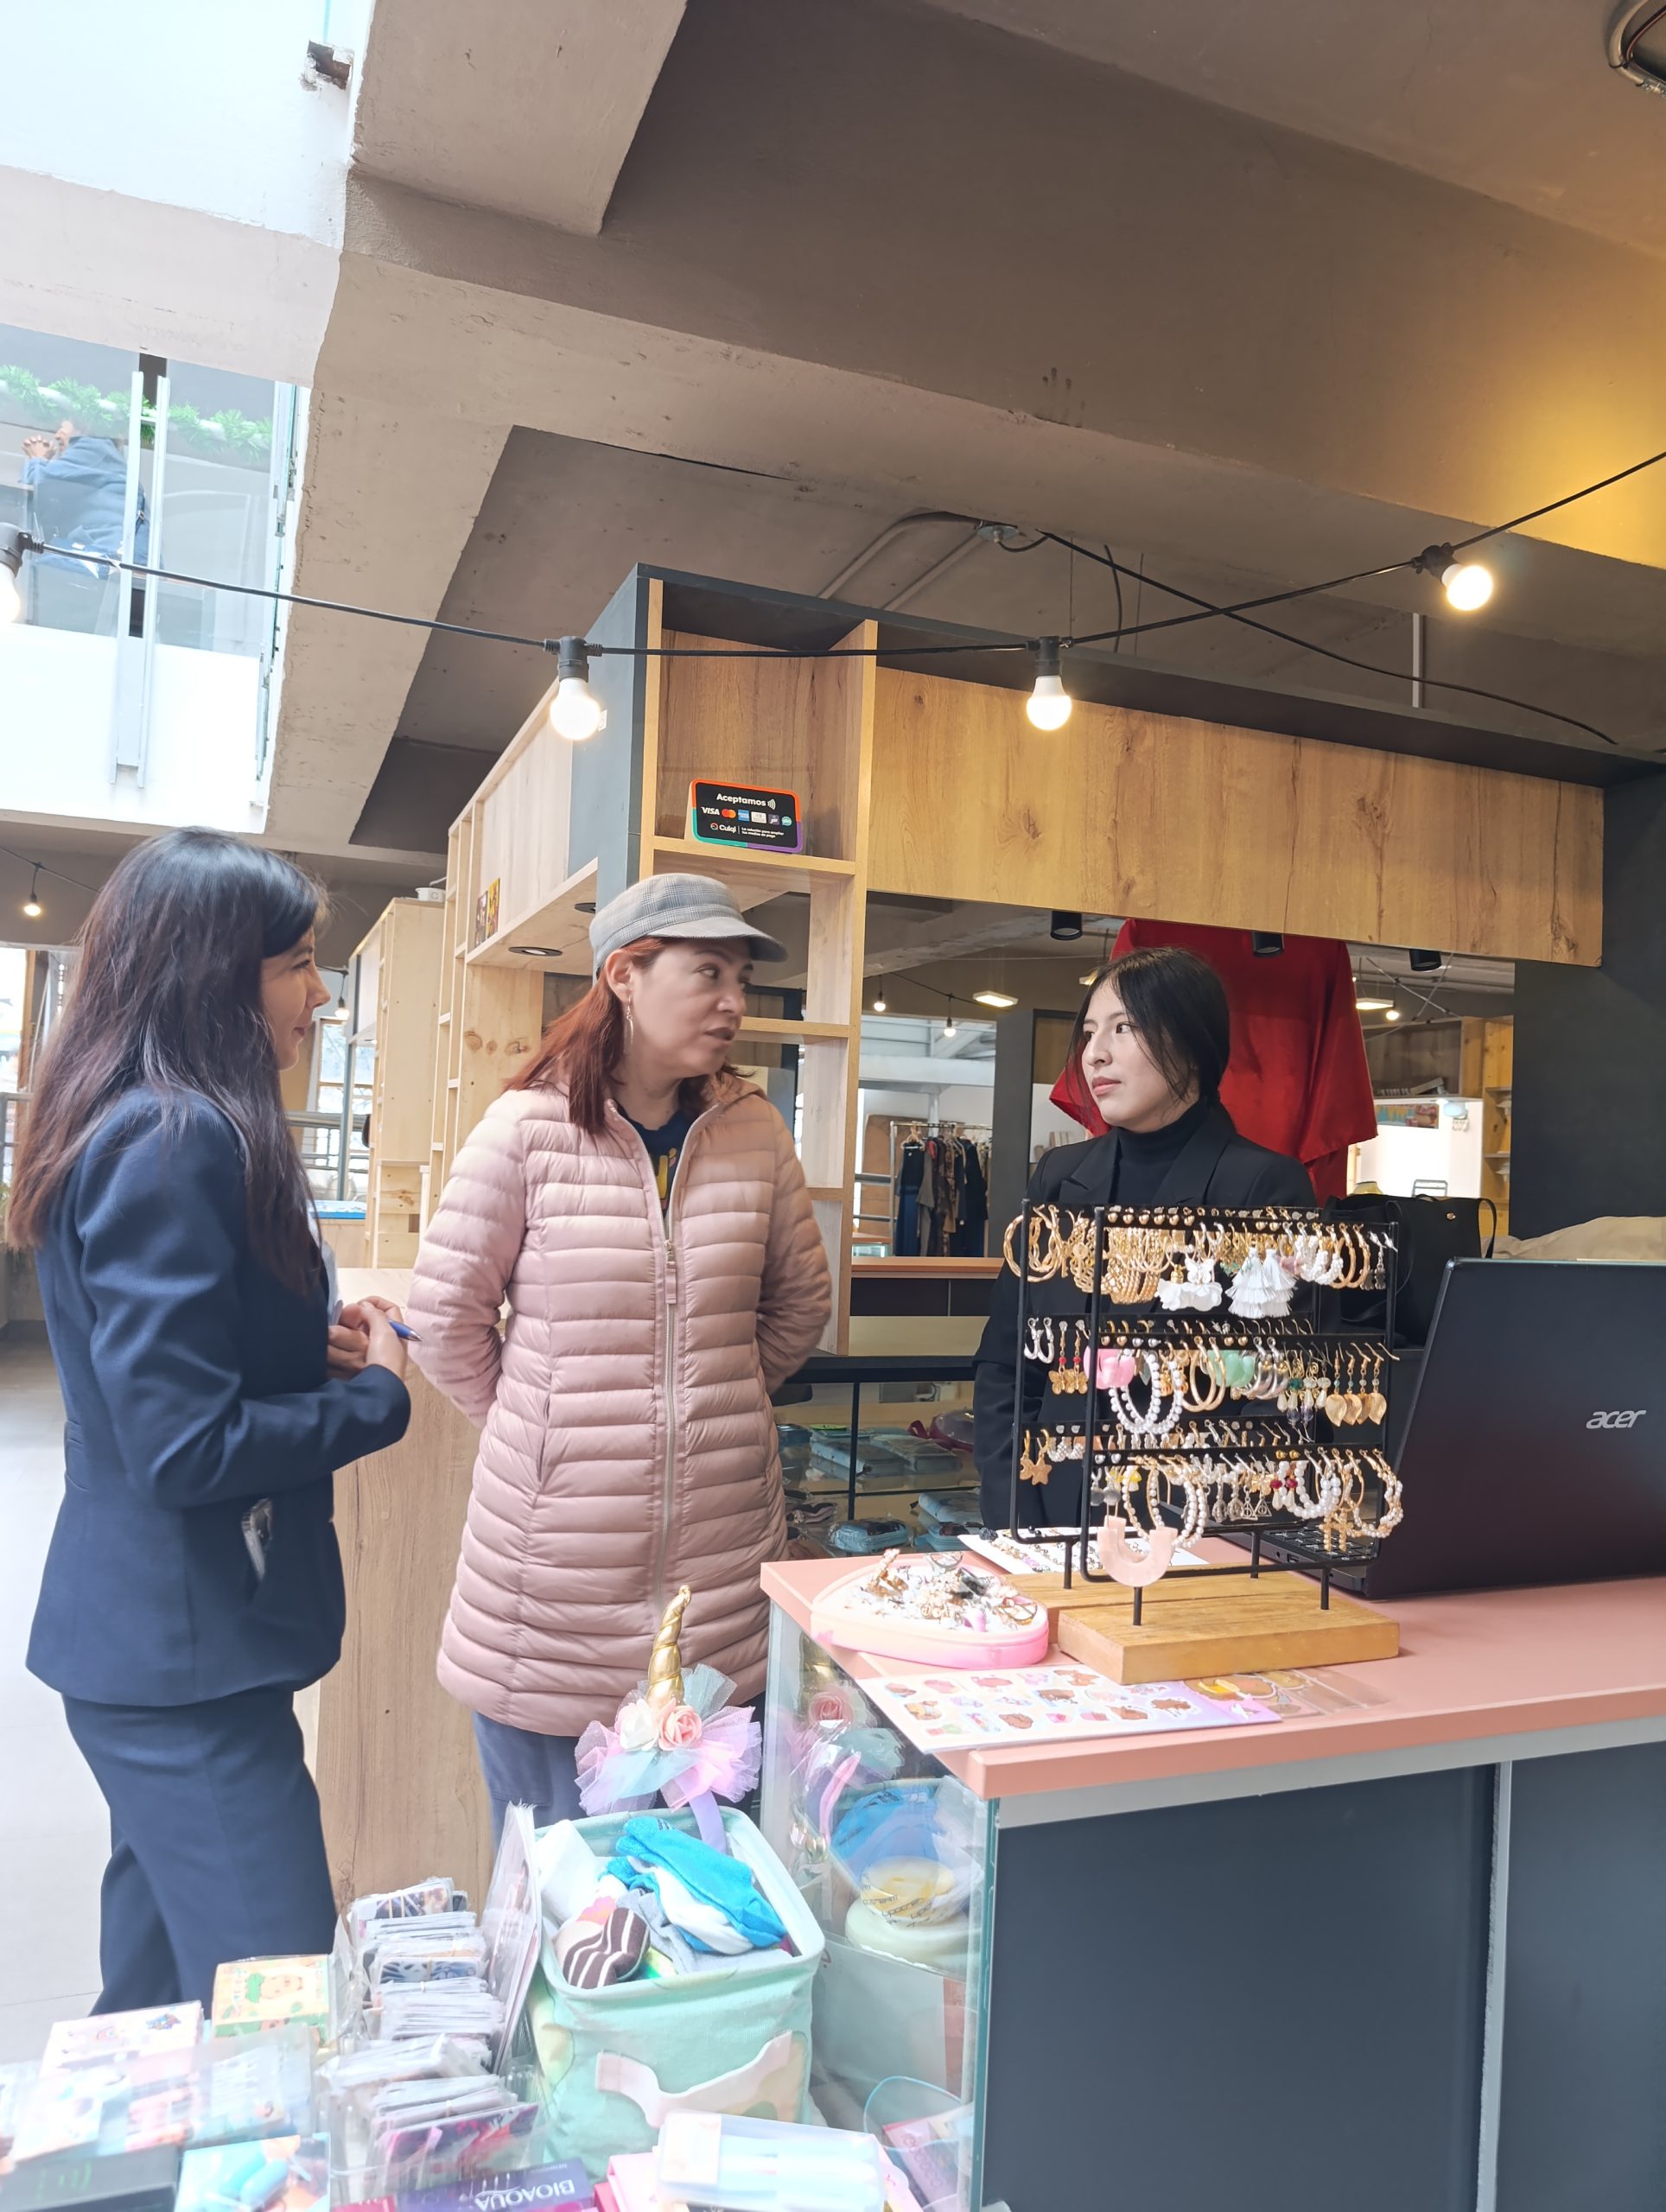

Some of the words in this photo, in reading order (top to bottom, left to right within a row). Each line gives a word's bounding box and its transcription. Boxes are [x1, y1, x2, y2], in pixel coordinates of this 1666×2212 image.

[716, 793, 766, 807] Aceptamos
[701, 806, 720, 816] VISA
[719, 823, 736, 834] Culqi
[1586, 1409, 1647, 1429] acer
[474, 2179, 575, 2211] BIOAQUA
